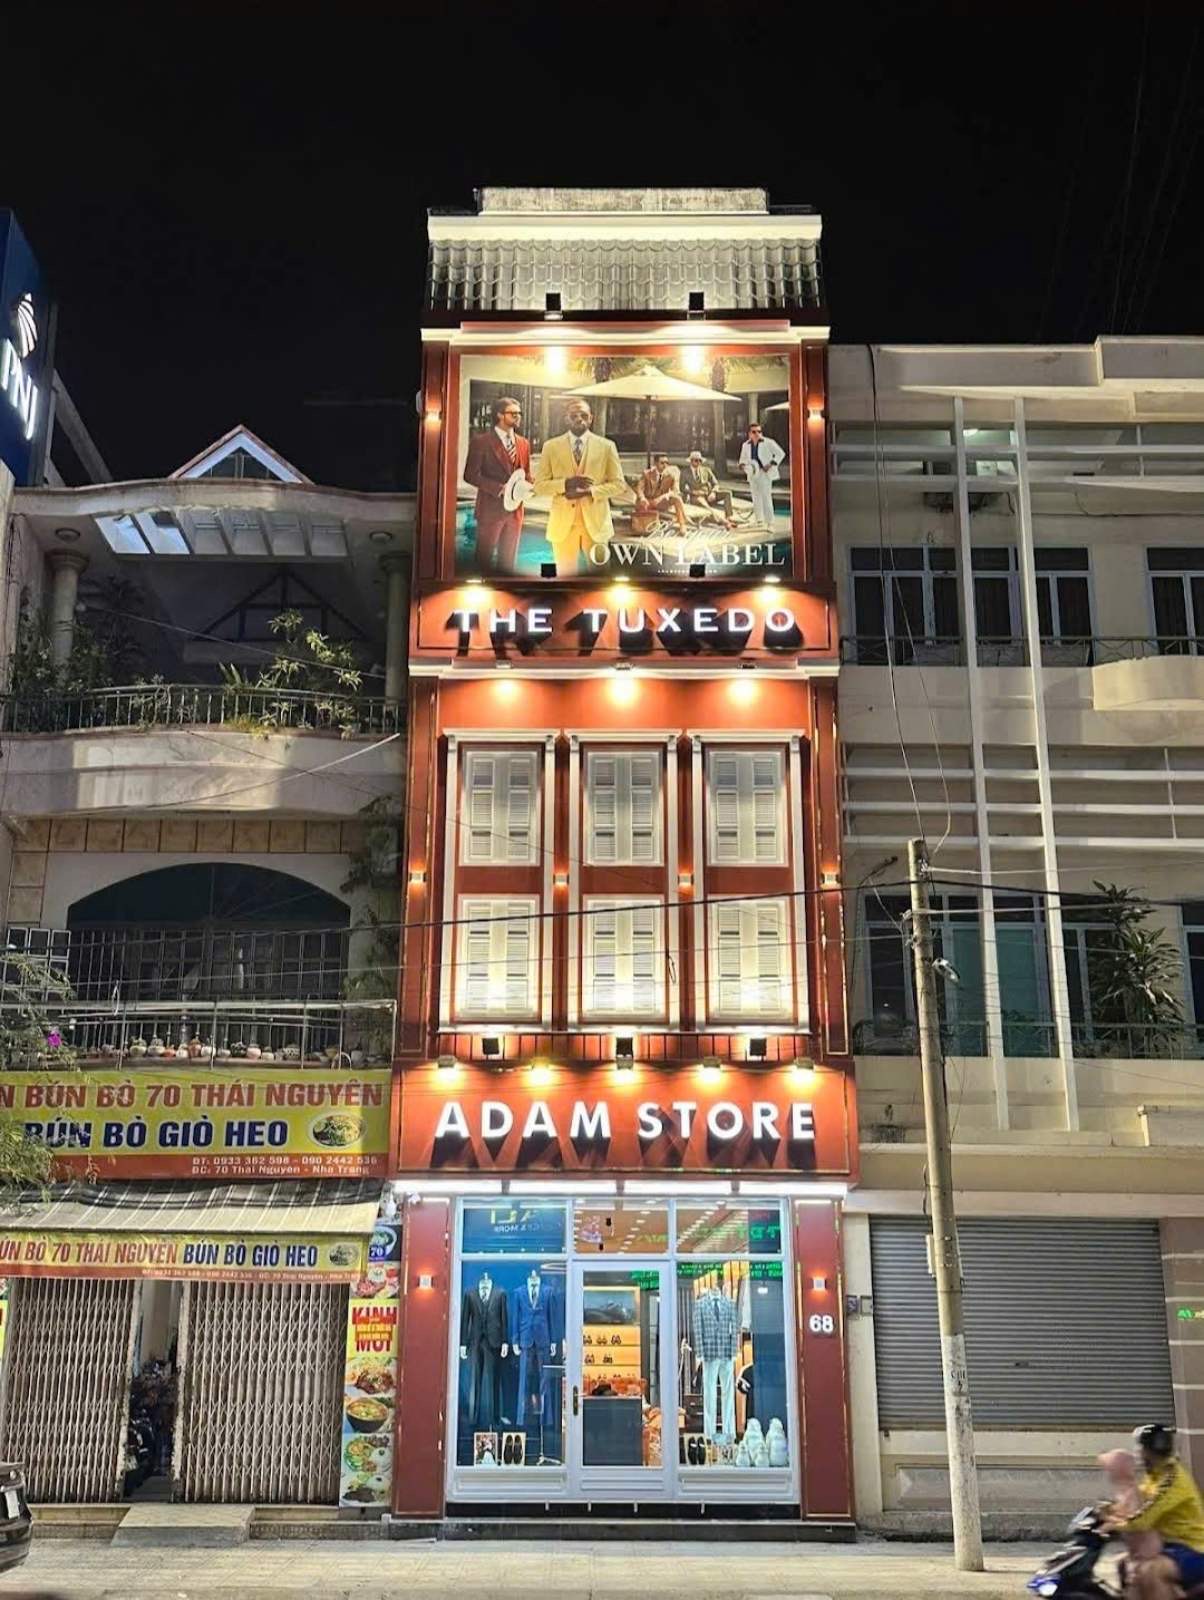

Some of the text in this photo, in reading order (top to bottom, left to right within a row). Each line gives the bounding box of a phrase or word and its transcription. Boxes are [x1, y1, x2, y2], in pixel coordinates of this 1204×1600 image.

[590, 543, 785, 566] OWN LABEL
[452, 608, 796, 632] THE TUXEDO
[25, 1080, 86, 1108] BÚN
[97, 1079, 135, 1108] BÒ
[147, 1085, 181, 1108] 70
[191, 1080, 255, 1107] THÁI
[265, 1079, 382, 1106] NGUYÊN
[104, 1115, 147, 1148] BÒ
[159, 1115, 213, 1147] GIÒ
[225, 1121, 288, 1147] HEO
[436, 1101, 814, 1139] ADAM STORE
[213, 1156, 240, 1165] 0933
[302, 1156, 322, 1165] 090
[327, 1156, 351, 1165] 2442
[215, 1165, 229, 1174] 70
[313, 1165, 334, 1175] Nha
[25, 1236, 47, 1262] BÒ
[52, 1242, 71, 1263] 70
[183, 1240, 218, 1265] BÚN
[224, 1239, 246, 1266] BÒ
[252, 1240, 280, 1267] GIÒ
[285, 1244, 318, 1267] HEO
[810, 1314, 833, 1333] 68
